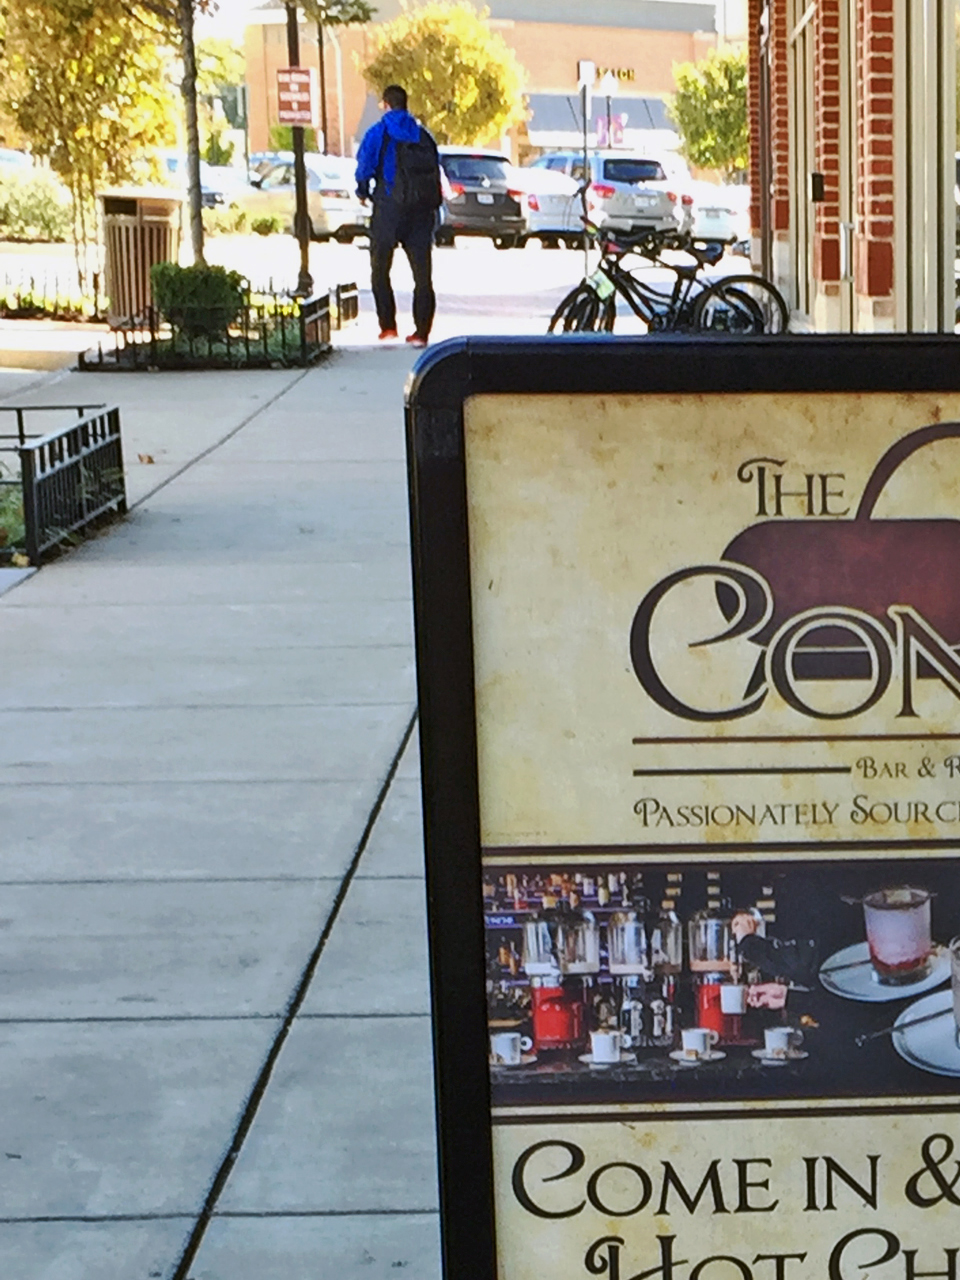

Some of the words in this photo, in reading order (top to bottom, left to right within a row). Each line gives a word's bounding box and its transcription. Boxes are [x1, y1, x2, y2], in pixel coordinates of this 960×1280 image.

[737, 457, 850, 518] THE
[856, 757, 907, 778] BAR
[918, 757, 934, 777] &
[634, 799, 839, 827] PASSIONATELY
[512, 1140, 779, 1219] COME
[803, 1155, 881, 1211] IN
